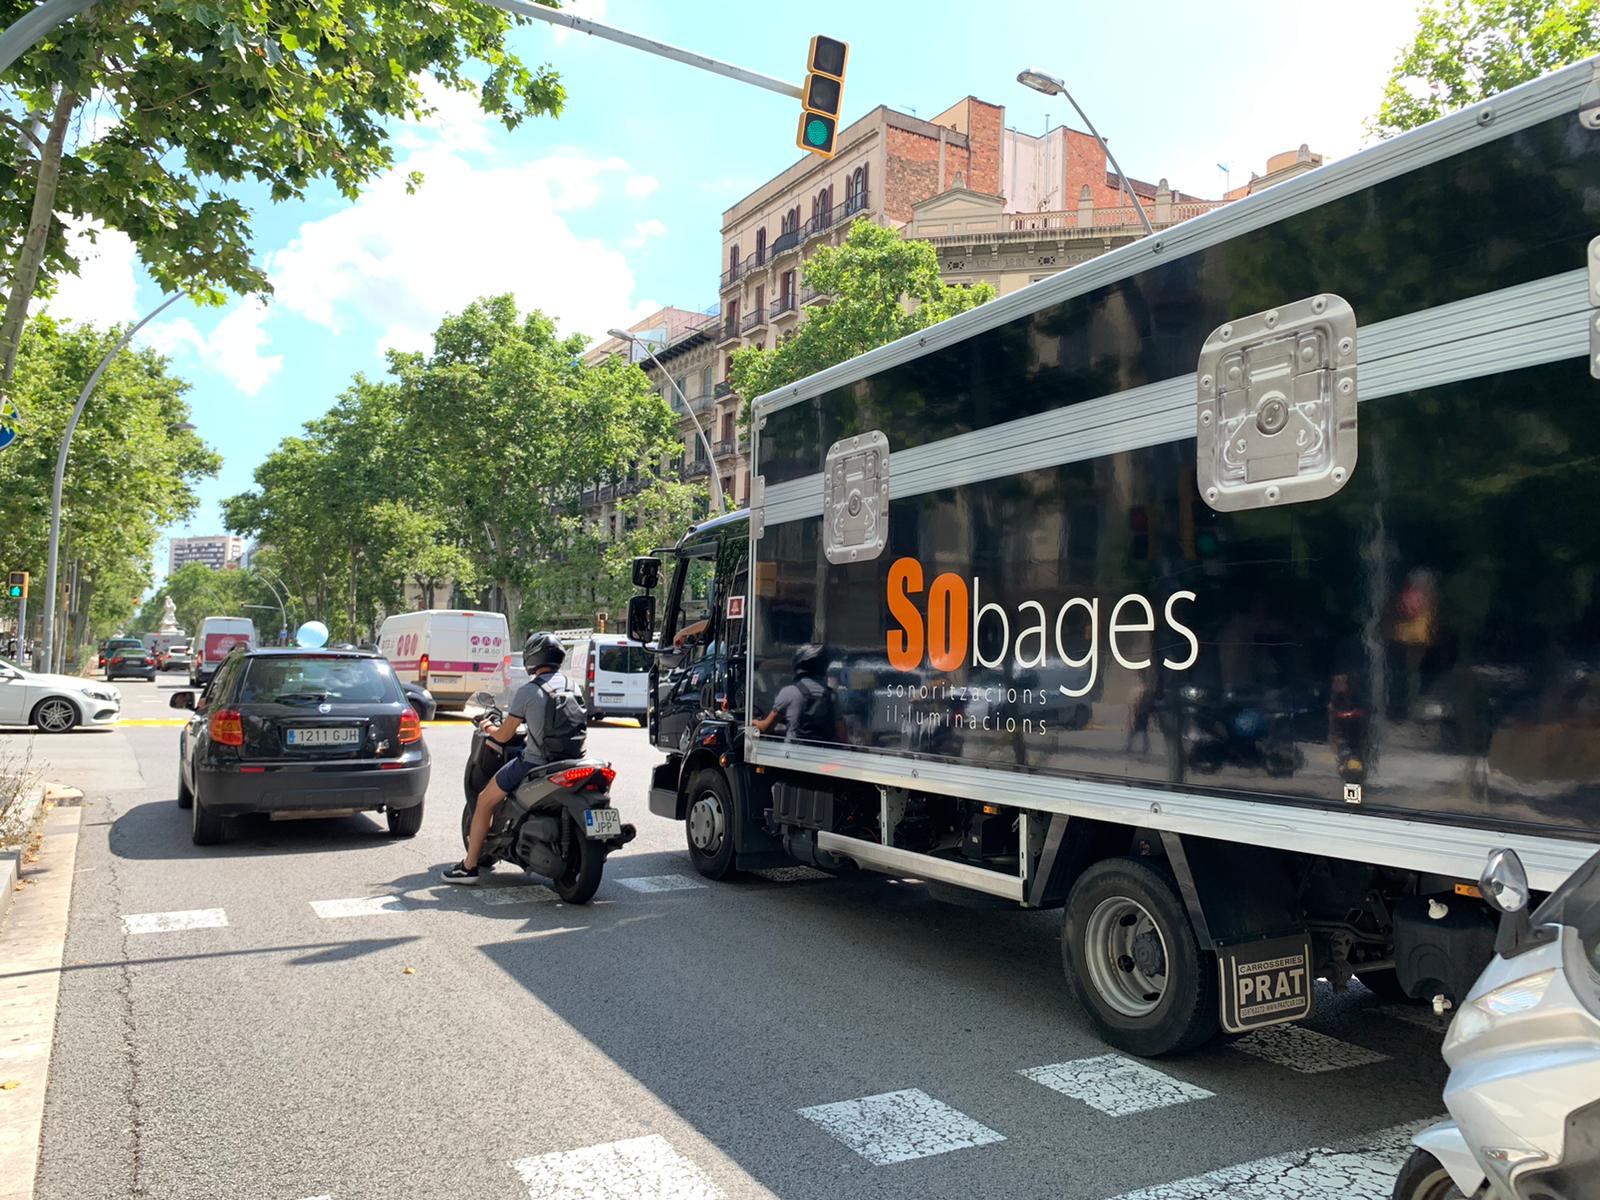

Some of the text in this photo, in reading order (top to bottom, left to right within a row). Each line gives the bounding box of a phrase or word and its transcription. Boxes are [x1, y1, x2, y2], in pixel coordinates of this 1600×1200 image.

[887, 681, 1047, 705] sonoritzacions
[300, 730, 357, 742] 1211 GJH
[593, 811, 617, 822] 1102
[595, 822, 612, 833] JPP
[1239, 955, 1303, 974] CARROSSERIES
[1239, 968, 1305, 1006] PRAT
